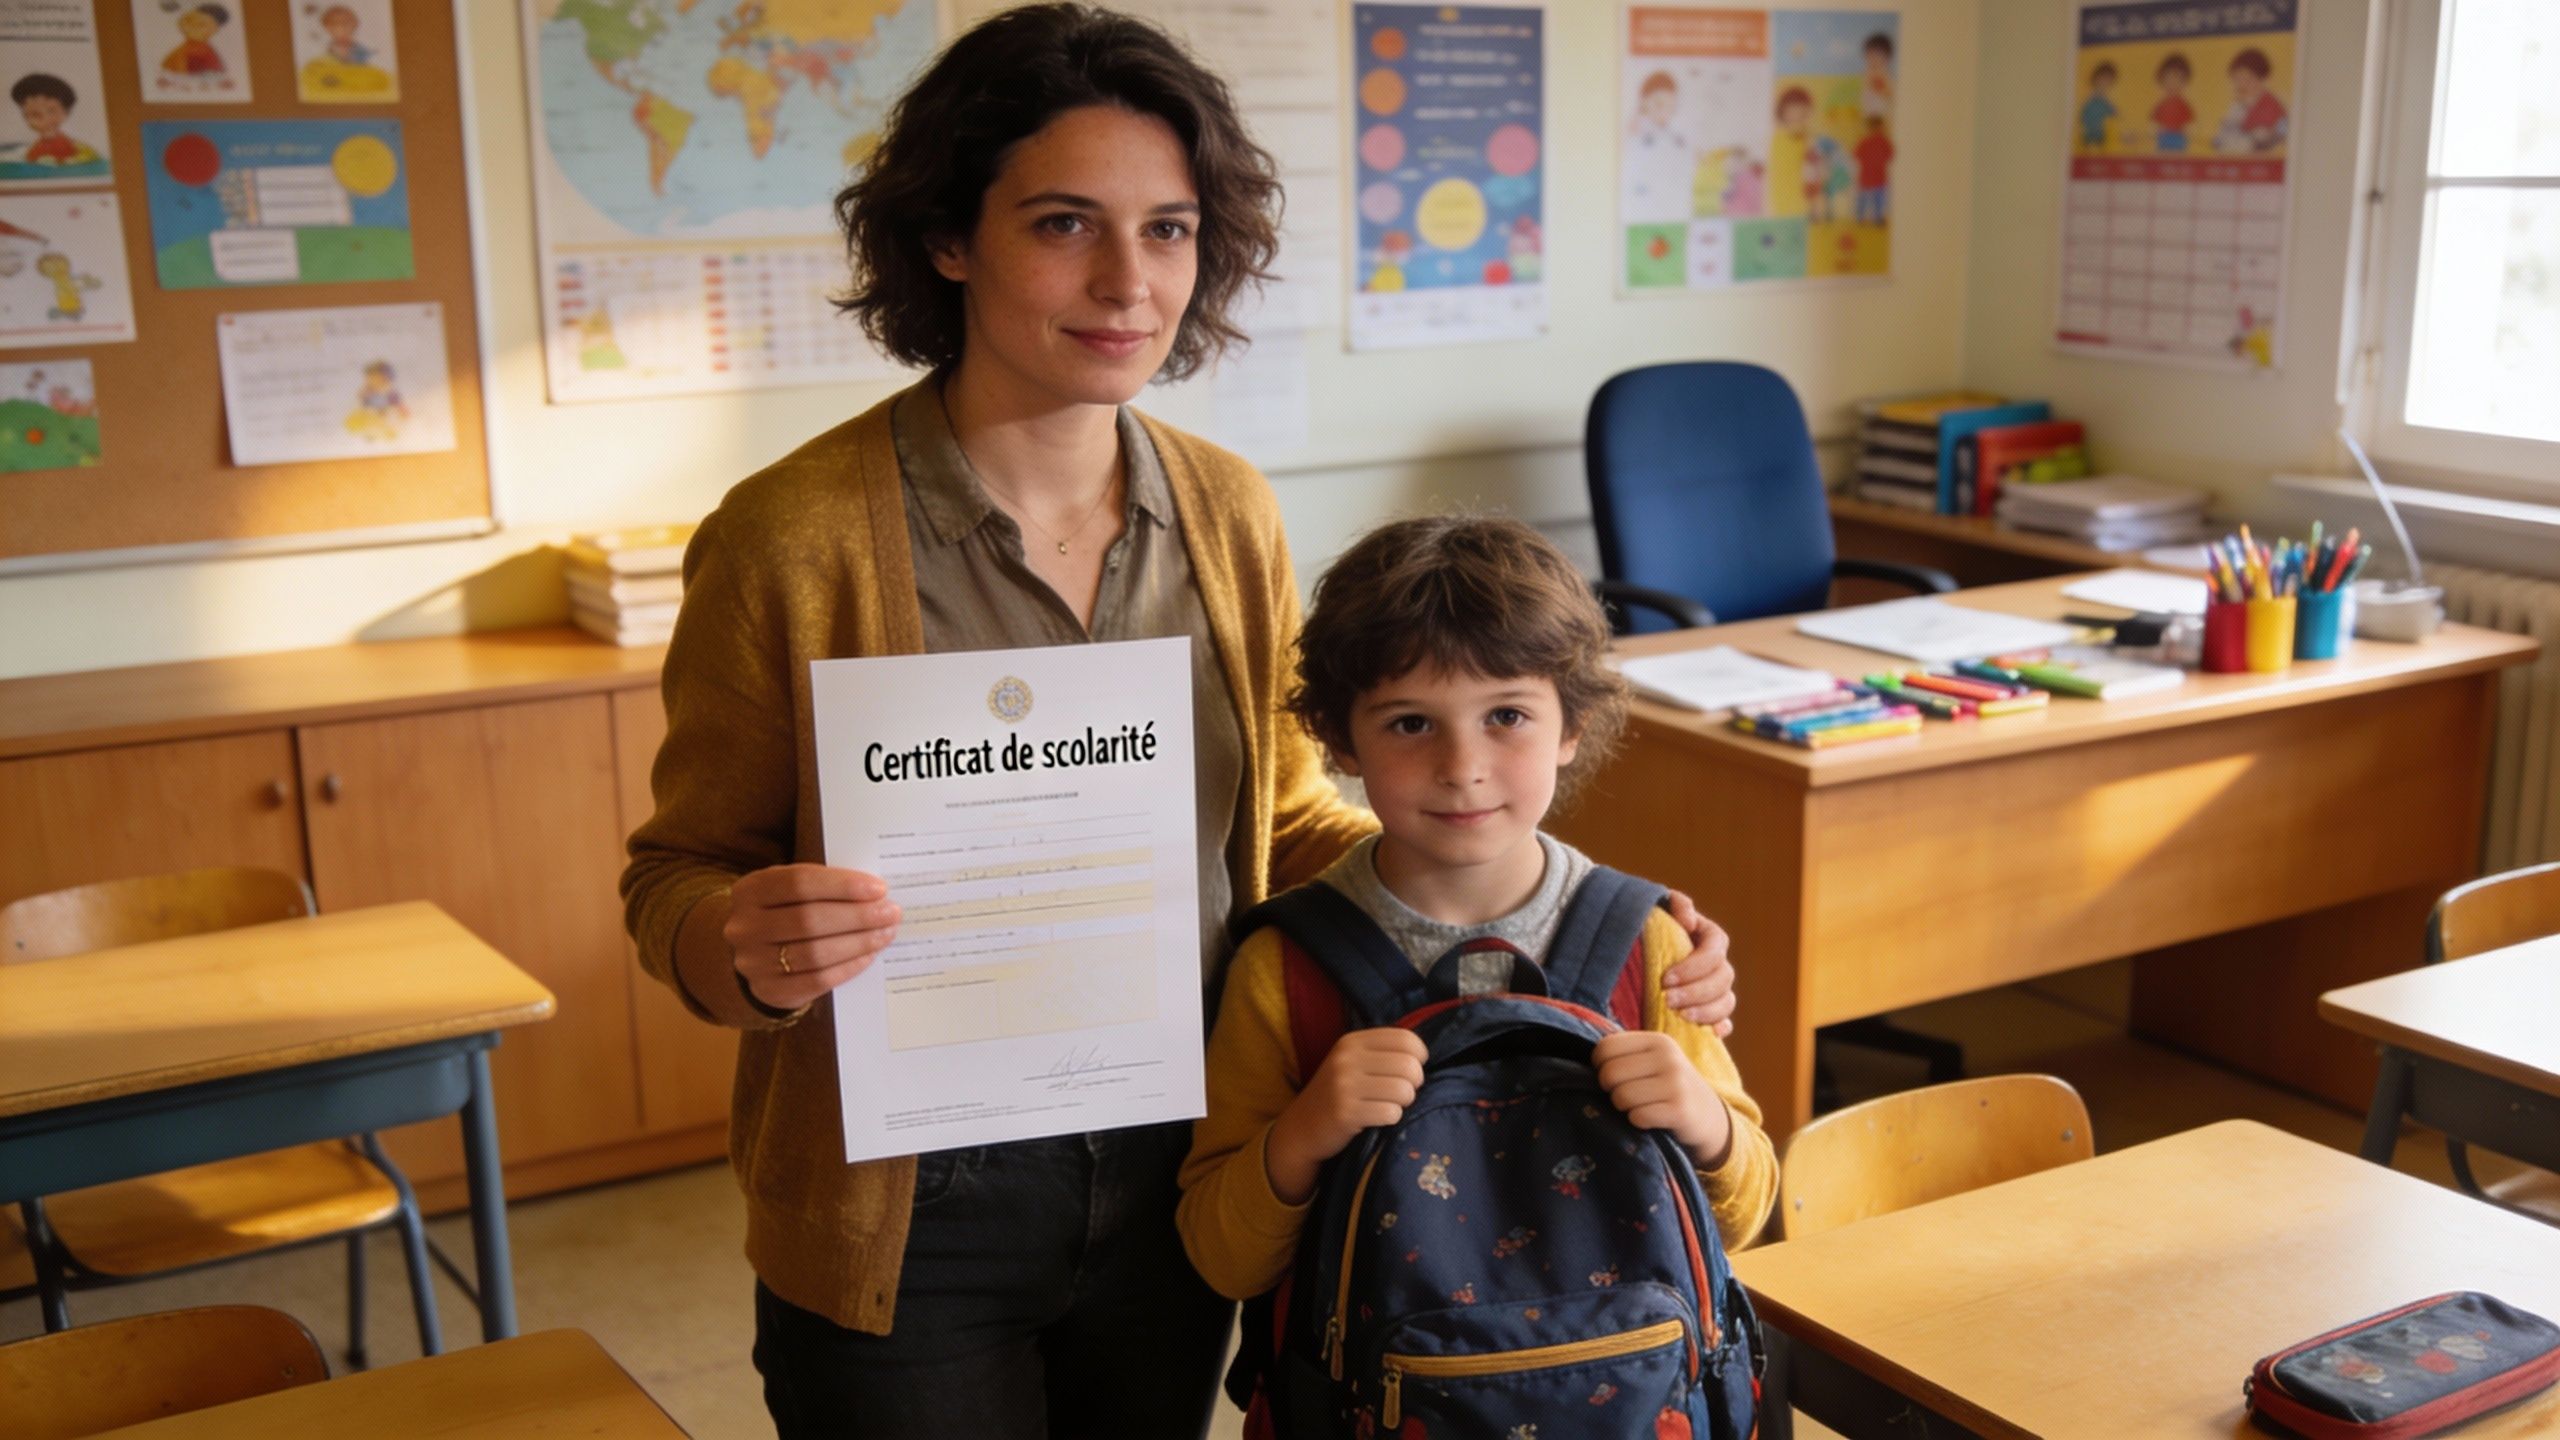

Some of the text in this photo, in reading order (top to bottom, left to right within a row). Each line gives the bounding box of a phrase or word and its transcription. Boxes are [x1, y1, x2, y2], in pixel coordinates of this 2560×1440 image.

[864, 720, 1157, 783] Certificat de scolarité
